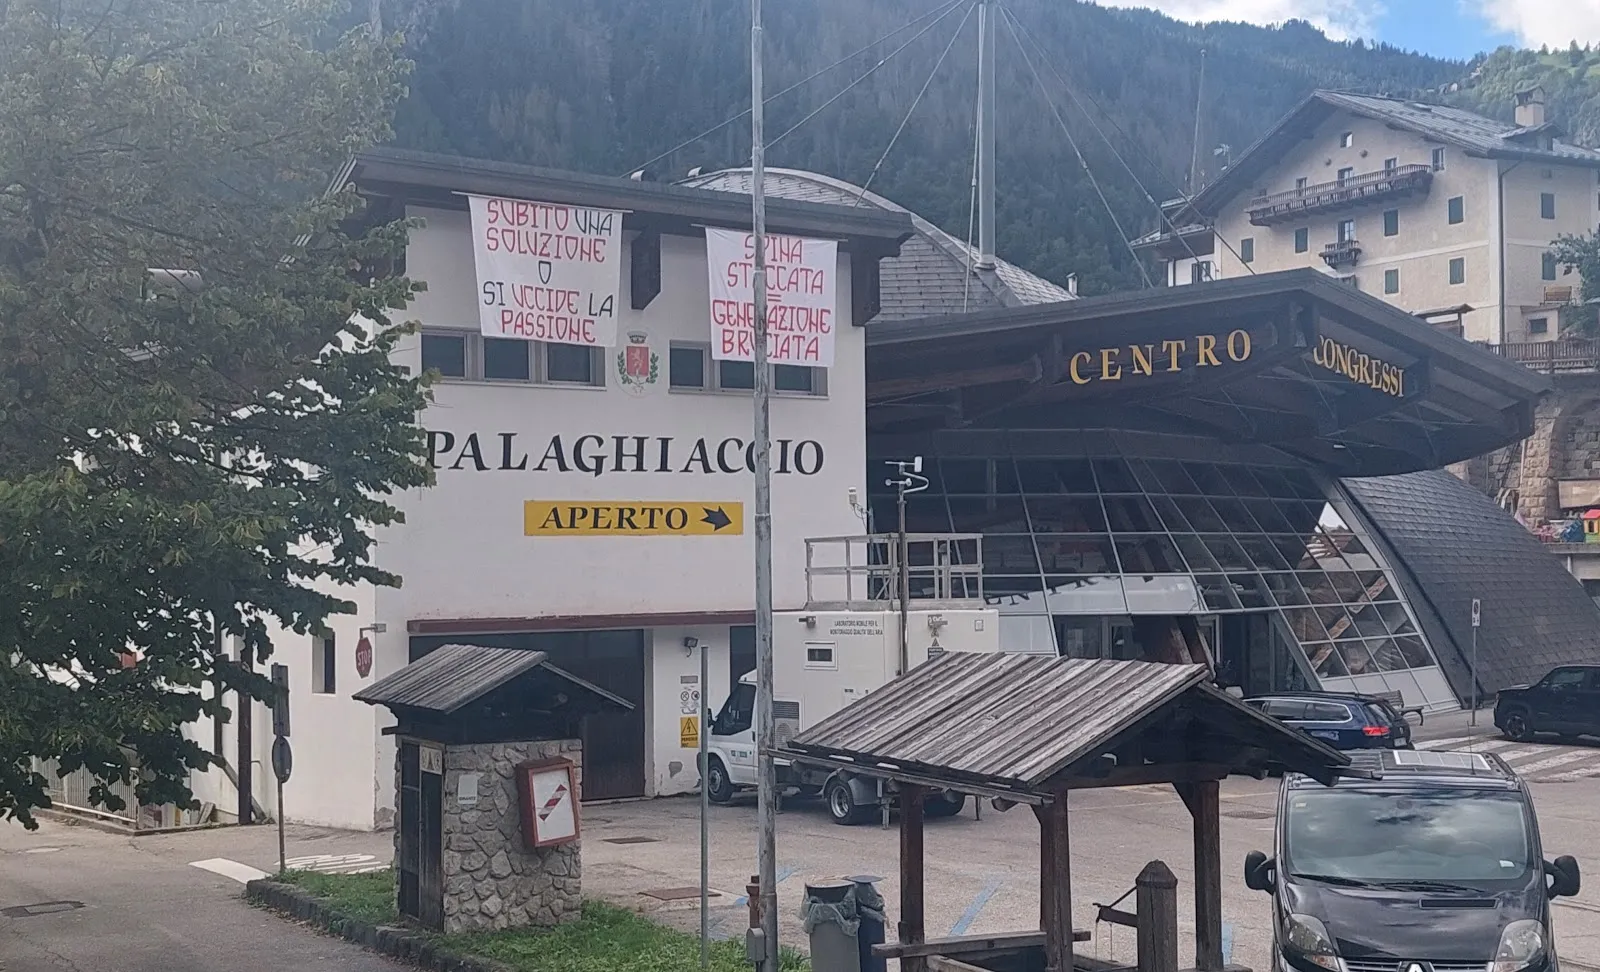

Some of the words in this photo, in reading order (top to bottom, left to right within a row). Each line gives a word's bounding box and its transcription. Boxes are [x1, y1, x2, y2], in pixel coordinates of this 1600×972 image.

[487, 200, 569, 231] SUBITO
[575, 209, 613, 236] UNA
[486, 227, 606, 263] SOLUZIONE
[538, 260, 552, 285] O
[727, 261, 824, 295] STCCATA
[483, 281, 506, 306] SI
[511, 283, 580, 314] UCCIDE
[588, 293, 613, 318] LA
[712, 299, 831, 334] GENEAZIONE
[501, 309, 596, 343] PASSIONE
[1069, 329, 1251, 385] CENTRO
[1313, 335, 1404, 397] CONGRESSI
[538, 506, 688, 531] APERTO
[357, 649, 371, 667] STOP
